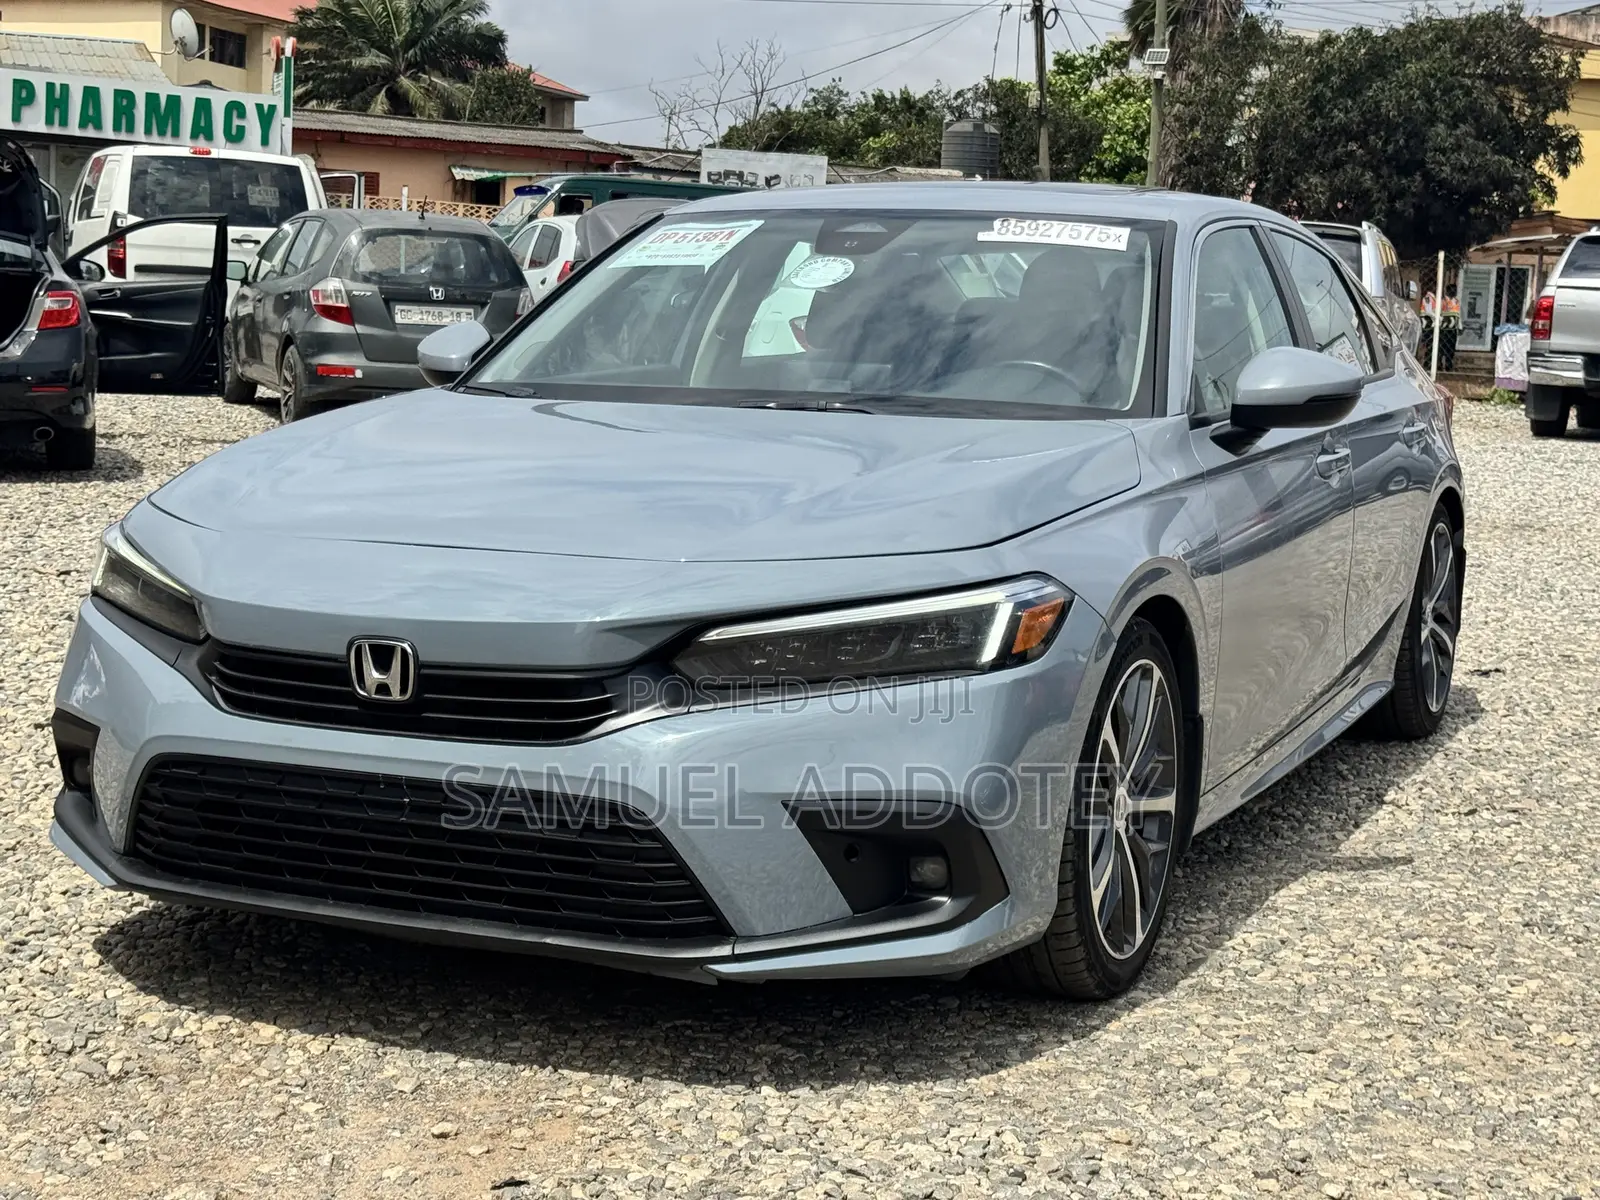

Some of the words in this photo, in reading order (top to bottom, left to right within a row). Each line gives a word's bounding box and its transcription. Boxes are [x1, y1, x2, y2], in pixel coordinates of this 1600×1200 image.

[11, 78, 277, 146] PHARMACY
[649, 232, 679, 244] DP
[722, 229, 741, 241] N
